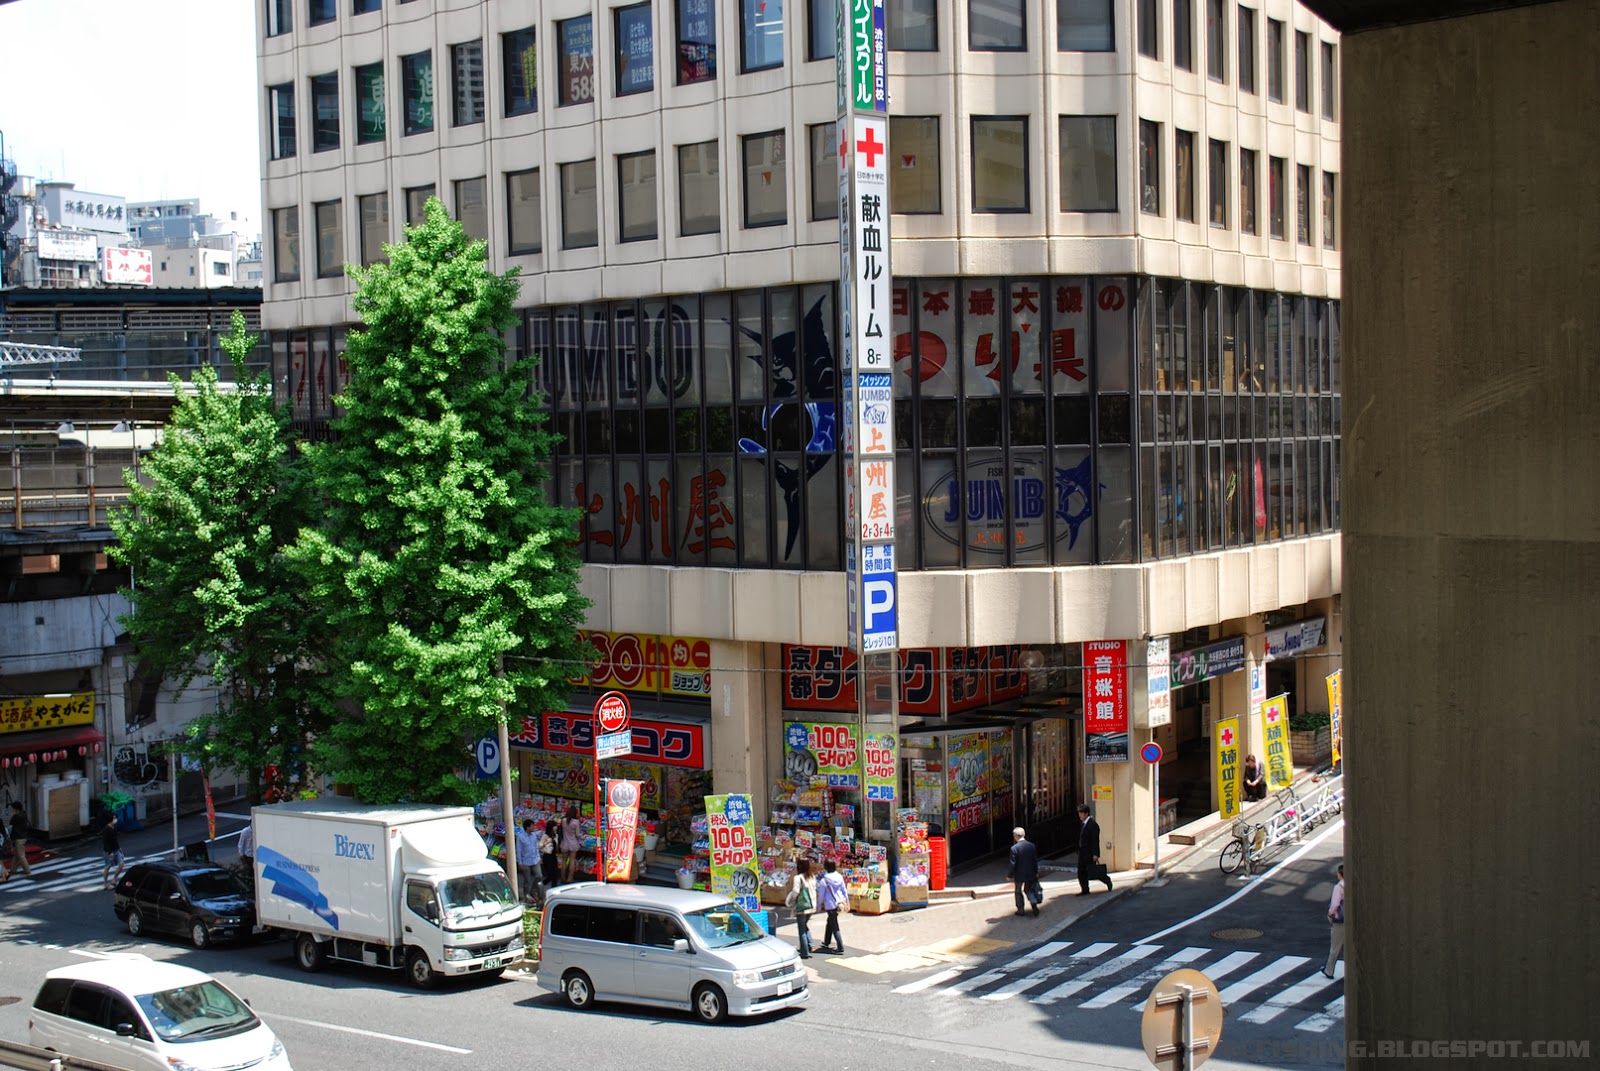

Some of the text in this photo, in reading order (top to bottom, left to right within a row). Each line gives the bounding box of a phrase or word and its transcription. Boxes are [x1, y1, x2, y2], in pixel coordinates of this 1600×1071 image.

[570, 49, 594, 73] 東大
[861, 194, 883, 338] 献血ルーム
[867, 348, 881, 365] 8F
[859, 374, 890, 386] フィッシング
[859, 389, 890, 401] JUMBO
[865, 427, 887, 519] 上州屋
[566, 469, 736, 558] 上州屋
[865, 545, 892, 557] 月極
[865, 558, 892, 571] 時間貸
[864, 580, 894, 630] P
[1088, 641, 1121, 651] STUDIO
[602, 706, 623, 721] 消火栓
[547, 716, 693, 762] 京都ダコク
[483, 742, 496, 768] P
[817, 749, 857, 768] SHOP
[867, 766, 895, 778] SHOP
[868, 786, 894, 800] 2階
[710, 814, 728, 826] 税込
[334, 833, 375, 860] Bizex!
[711, 827, 752, 849] 100円
[714, 849, 753, 866] SHOP
[733, 872, 757, 887] 100
